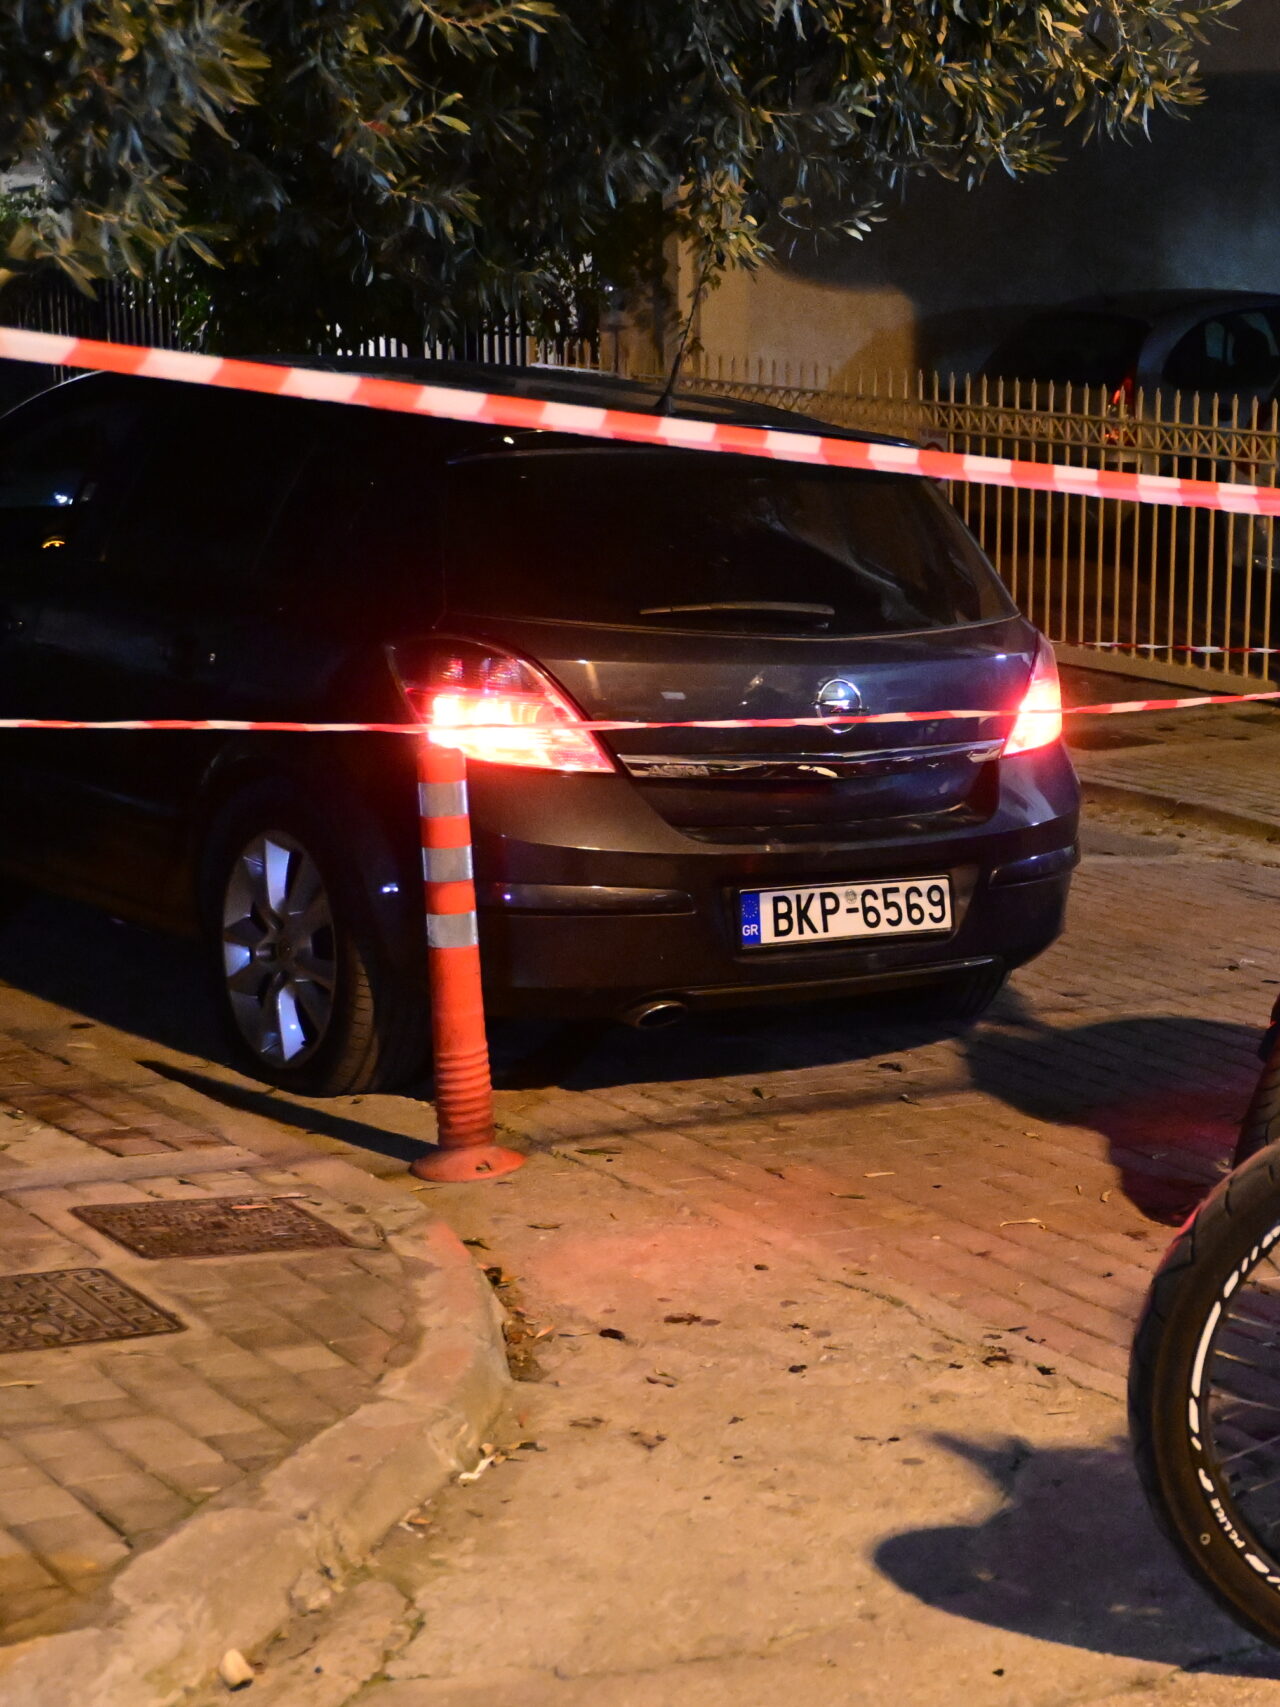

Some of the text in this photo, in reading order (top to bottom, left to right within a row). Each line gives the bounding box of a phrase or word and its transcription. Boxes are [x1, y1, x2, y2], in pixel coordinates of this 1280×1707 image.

[647, 764, 710, 777] ASTRA
[741, 923, 759, 937] GR
[1210, 1497, 1246, 1549] POLICE
